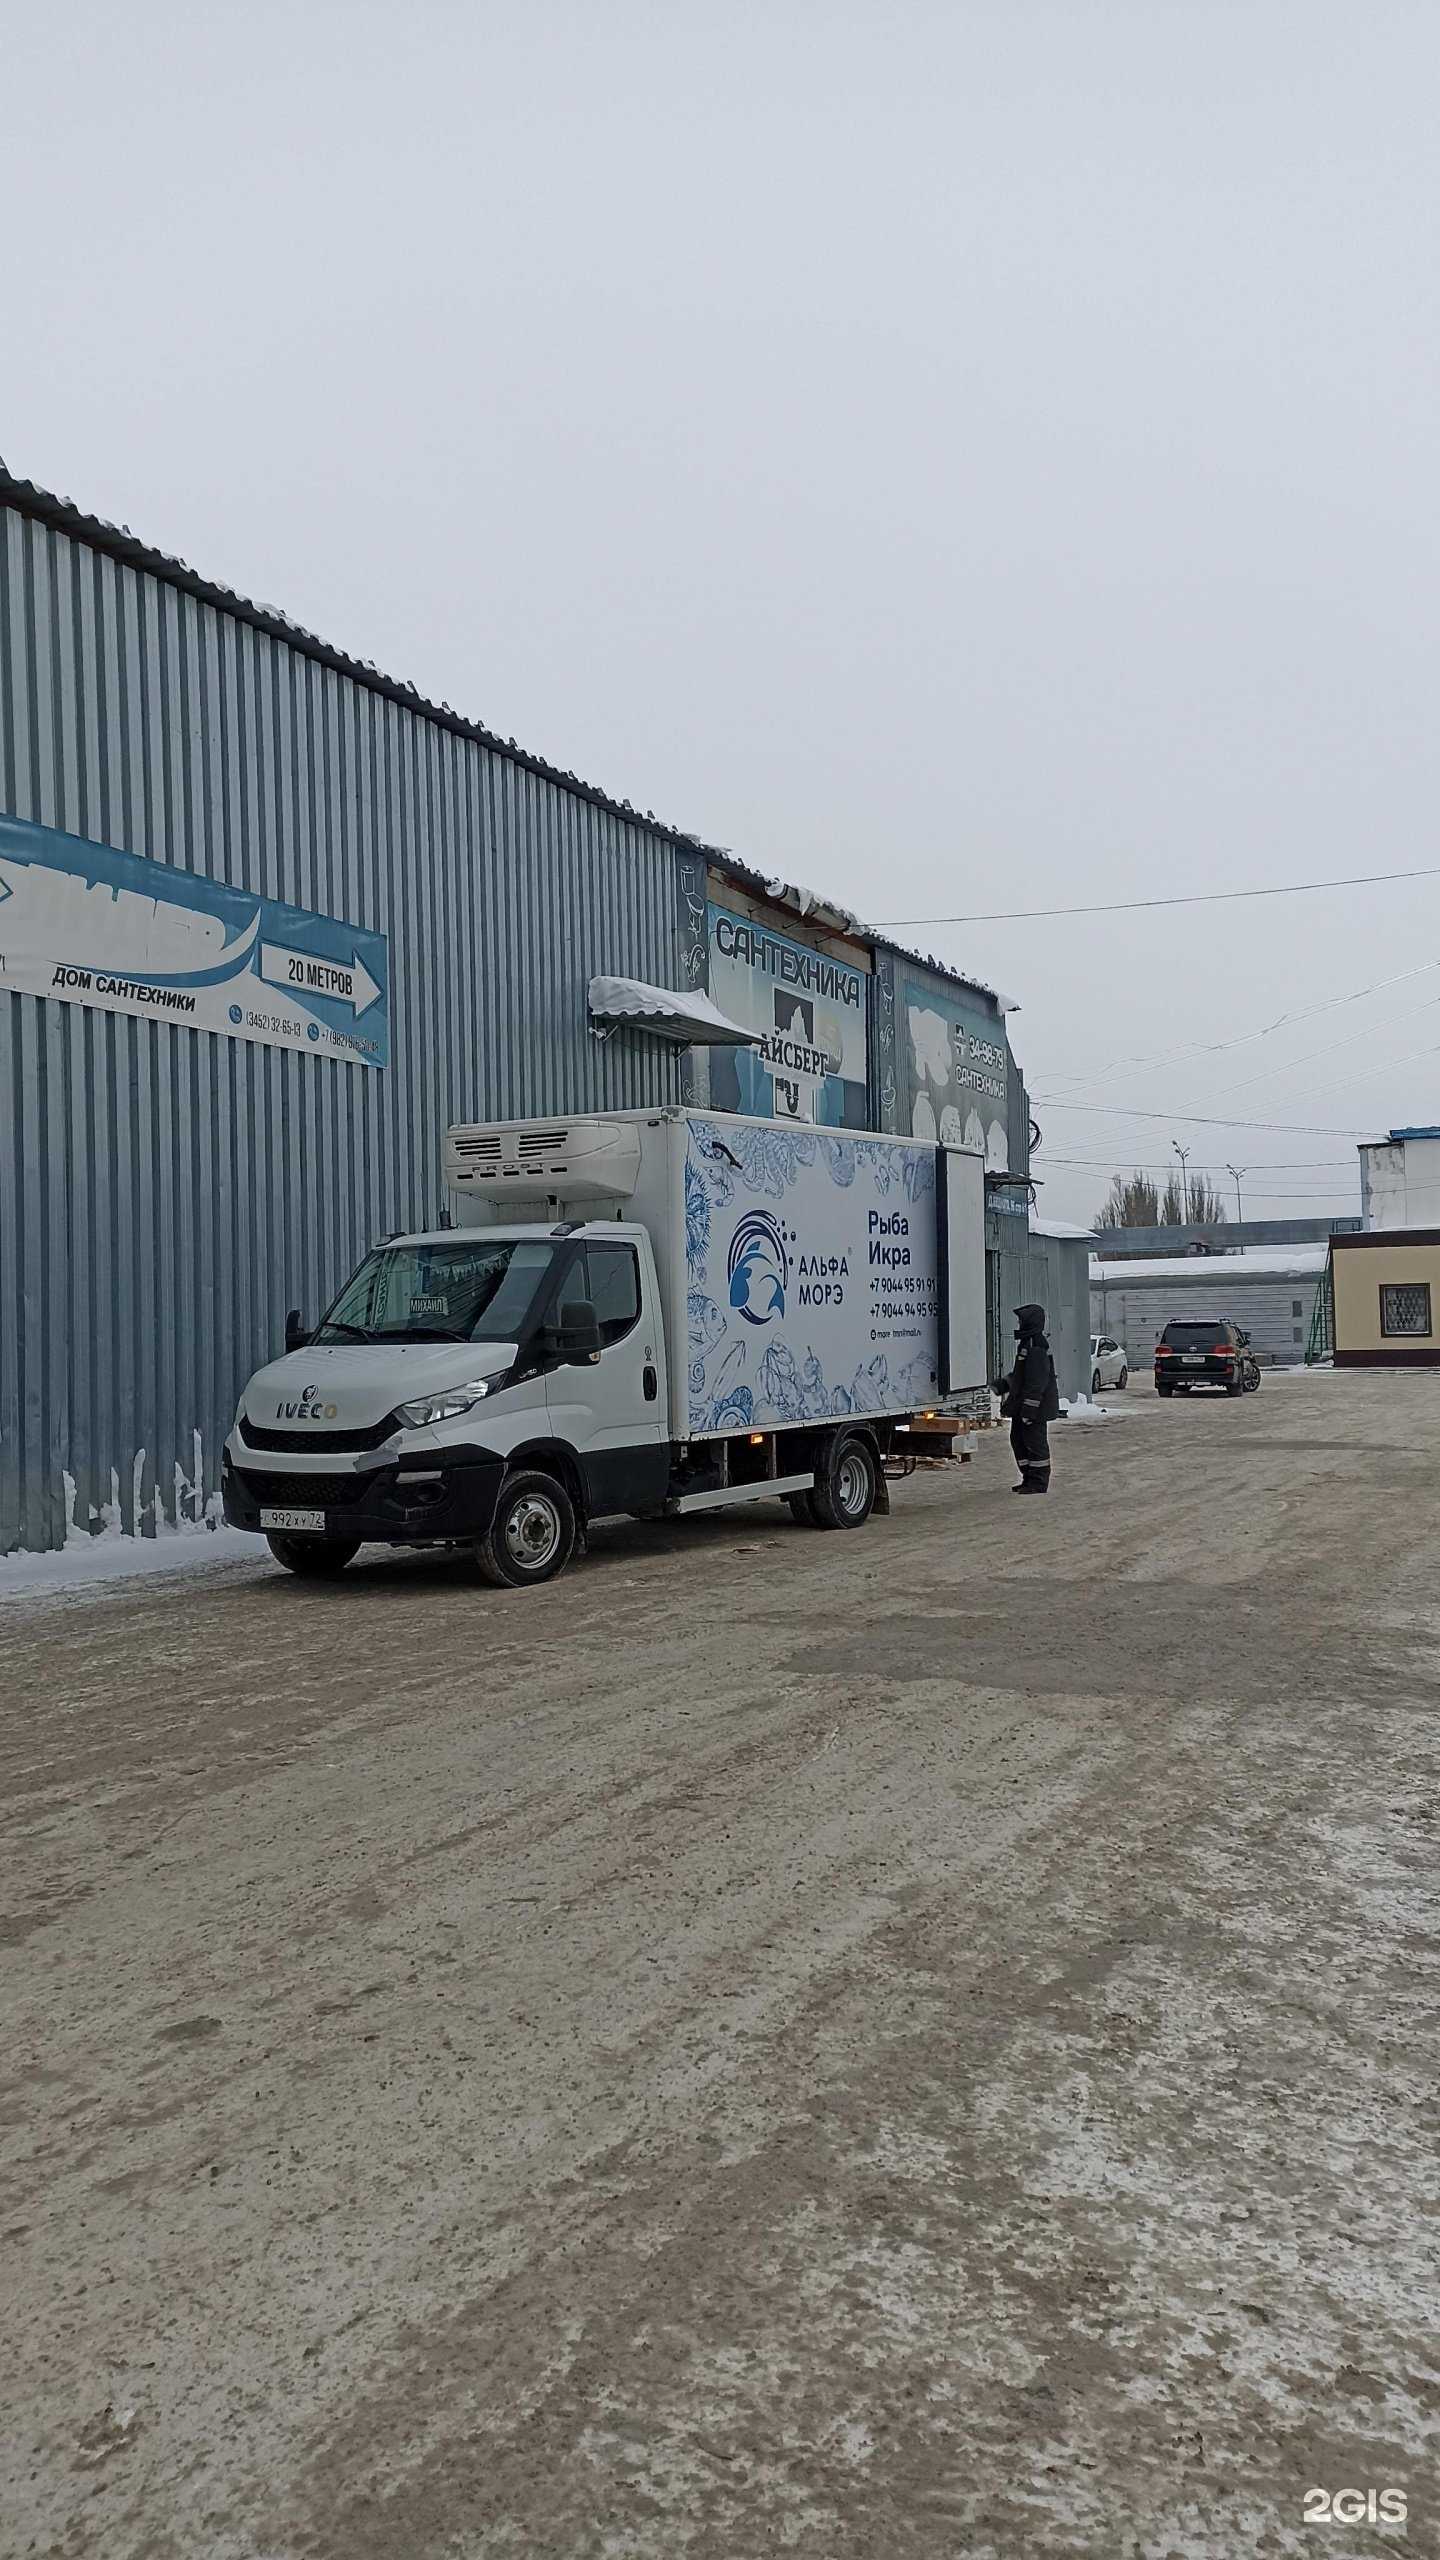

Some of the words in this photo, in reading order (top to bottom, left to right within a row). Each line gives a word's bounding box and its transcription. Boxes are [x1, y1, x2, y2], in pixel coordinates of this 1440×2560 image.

[716, 916, 860, 1008] САНТЕХНИКА
[288, 958, 304, 982] 20
[307, 963, 353, 995] МЕТРОВ
[52, 967, 91, 989] ДОМ
[95, 976, 196, 1012] САНТЕХНИКИ
[759, 1033, 829, 1077] АЙСБЕРГ
[955, 1064, 1006, 1101] САНТЕХНИКА
[868, 1210, 909, 1235] Рыба
[798, 1255, 849, 1276] АЛЬФА
[869, 1240, 911, 1270] Икра
[799, 1284, 843, 1305] МОРЭ
[869, 1277, 880, 1292] +7
[881, 1277, 903, 1293] 9044
[904, 1277, 915, 1293] 95
[916, 1277, 925, 1292] 91
[410, 1299, 443, 1312] МИХАИЛ
[870, 1303, 880, 1317] +7
[881, 1302, 904, 1318] 9044
[905, 1302, 915, 1317] 94
[916, 1302, 927, 1317] 95
[276, 1402, 337, 1419] IVECO
